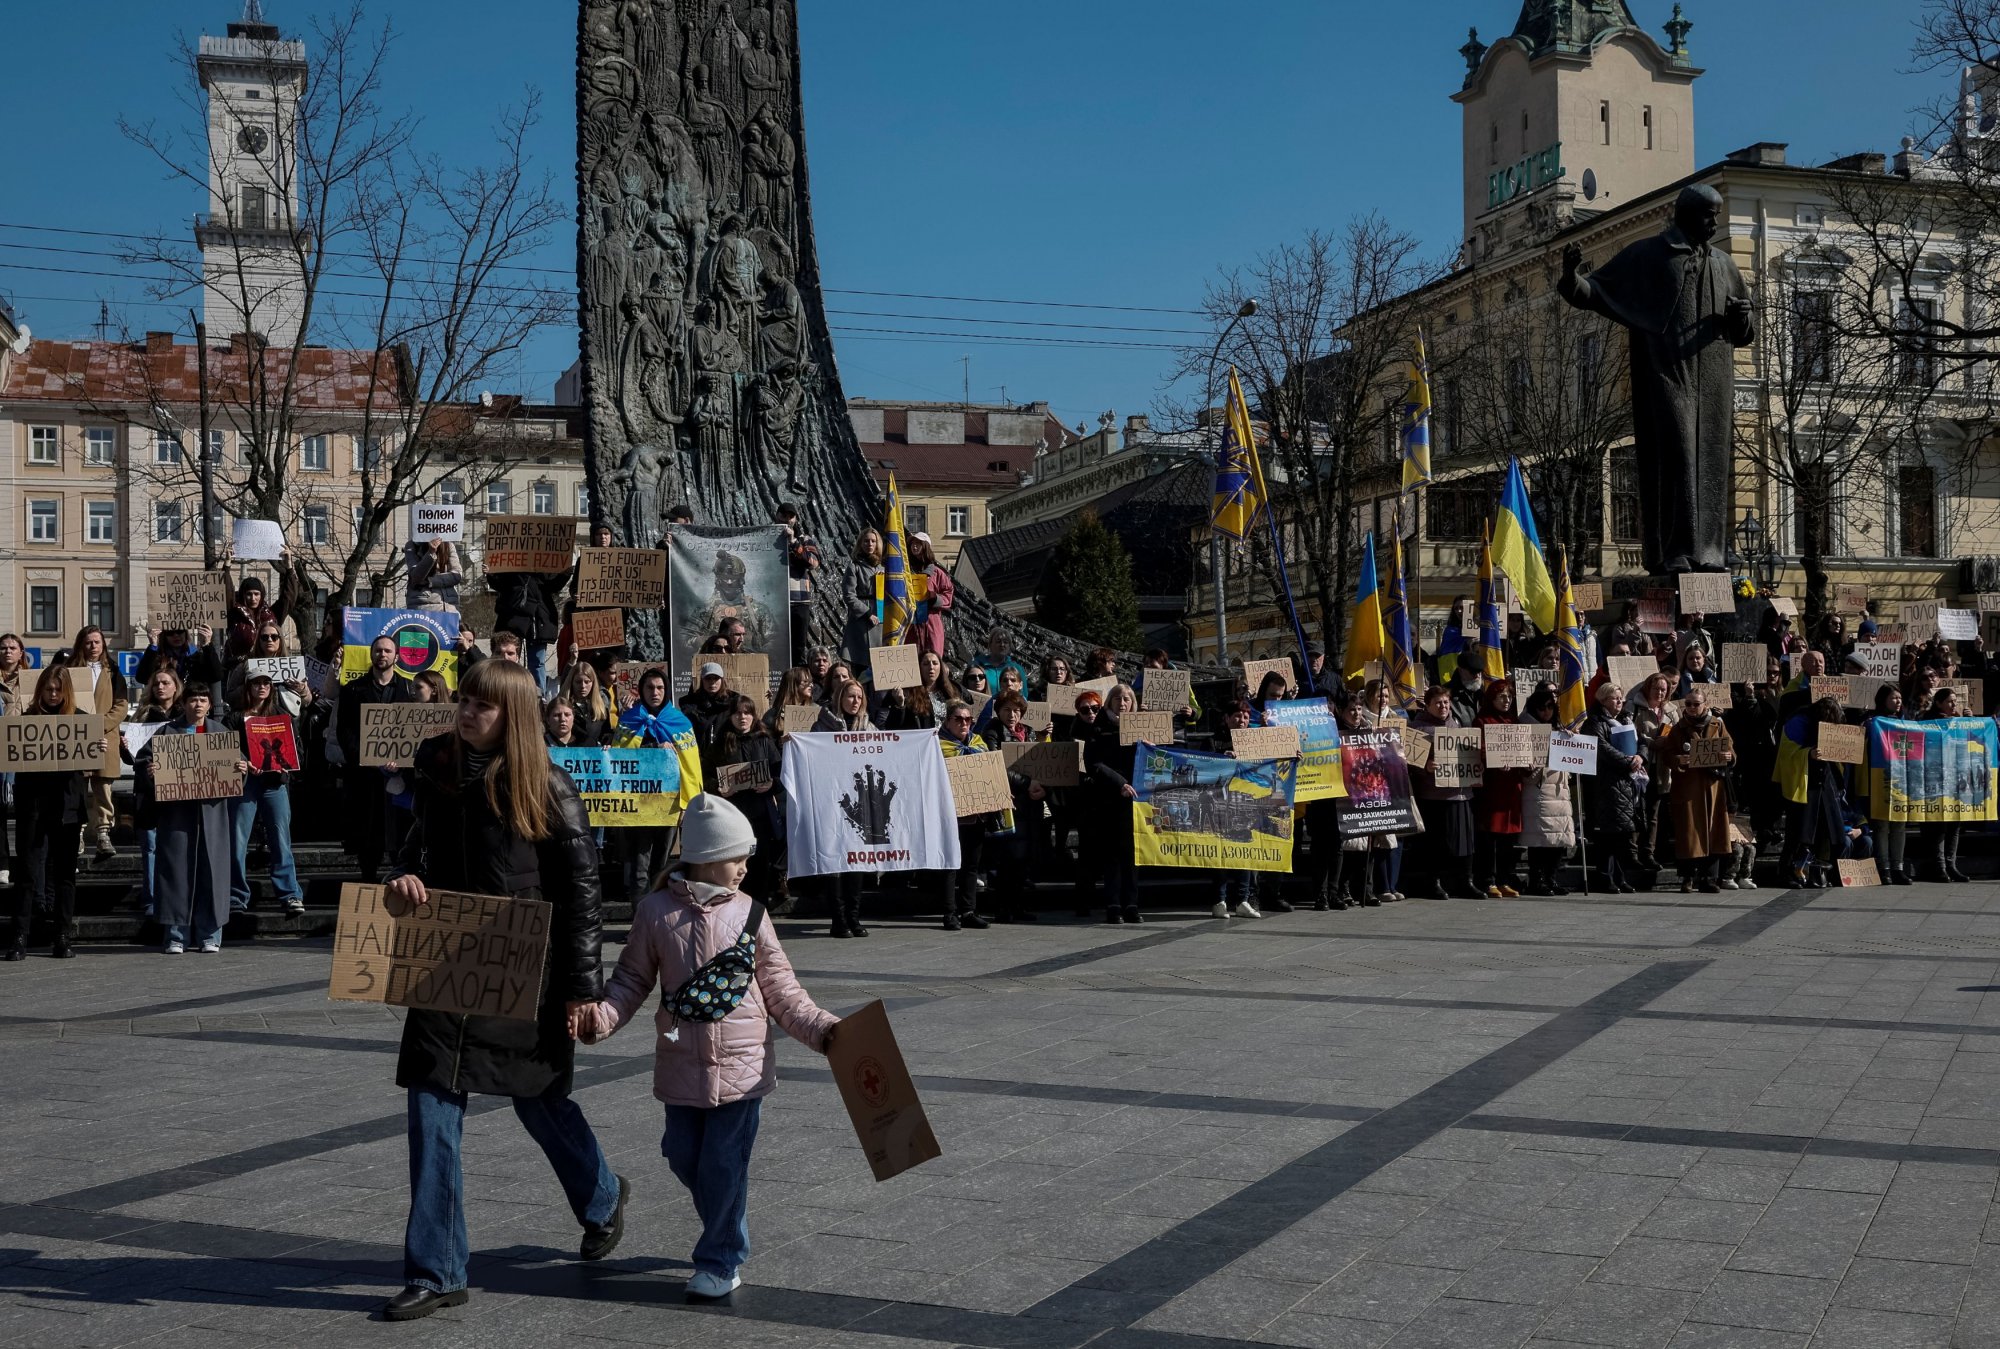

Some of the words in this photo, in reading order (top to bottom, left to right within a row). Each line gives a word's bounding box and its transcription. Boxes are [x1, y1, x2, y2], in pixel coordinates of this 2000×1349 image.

[1489, 141, 1566, 209] HOTEL
[418, 509, 454, 520] ПОЛОН
[417, 523, 458, 534] ВБИВАЄ
[488, 521, 518, 536] DON'T
[521, 523, 533, 536] BE
[488, 537, 542, 551] CAPTIVITY
[489, 553, 529, 567] #FREE
[533, 553, 569, 569] AZOV
[586, 552, 613, 565] THEY
[617, 553, 660, 566] FOUGHT
[600, 566, 622, 579] FOR
[626, 566, 642, 579] US!
[150, 575, 165, 587] НЕ
[171, 573, 227, 587] ДОПУСТИ
[581, 577, 597, 590] IT'S
[600, 579, 621, 591] OUR
[623, 580, 648, 592] TIME
[650, 581, 662, 593] TO
[174, 585, 198, 593] ЩОБ
[1572, 585, 1600, 598] FREE
[580, 592, 609, 604] FIGHT
[612, 592, 632, 604] FOR
[1685, 590, 1705, 603] БУТИ
[157, 611, 214, 621] ВМИРАЛИ
[220, 610, 228, 620] В
[162, 620, 206, 631] ПОЛОН
[378, 613, 412, 637] оверніть
[576, 616, 618, 631] ПОЛОН
[576, 627, 624, 648] ВБИВАЄ
[879, 649, 908, 664] FREE
[1724, 644, 1754, 656] БУДЬ
[125, 654, 139, 674] P
[257, 657, 298, 670] FREE
[1867, 664, 1898, 677] ИВАЄ
[268, 669, 301, 682] ZOV
[345, 671, 369, 681] 302
[880, 668, 914, 684] AZOV
[1147, 671, 1185, 680] ЧЕКАЮ
[1147, 680, 1186, 692] АЗОВЦЯ
[365, 705, 405, 726] ГЕРОЇ
[792, 710, 816, 722] ПОЛ
[1023, 709, 1047, 721] ОВЧИ
[1310, 716, 1329, 727] 3033
[7, 723, 87, 742] ПОЛОН
[367, 725, 406, 739] ДОСІ
[412, 725, 423, 739] У
[834, 733, 900, 743] ПОВЕРНІТЬ
[204, 732, 240, 750] ТВОРИТЬ
[1438, 736, 1478, 751] ПОЛОН
[1551, 739, 1596, 751] ЗВІЛЬНІТЬ
[1696, 739, 1728, 753] FREE
[1826, 734, 1856, 747] ПОЛОН
[7, 741, 98, 762] ВБИВАЄ
[853, 746, 883, 754] АЗОВ
[1017, 745, 1070, 761] ПОЛОН
[1824, 746, 1856, 761] ВБИВАЄ
[153, 754, 161, 770] З
[564, 759, 601, 773] SAVE
[610, 760, 639, 774] THE
[956, 753, 1000, 770] МОВЧИ
[1298, 753, 1339, 767] УПОЛЯ
[1533, 756, 1548, 765] AZO
[1561, 756, 1584, 765] АЗОВ
[176, 769, 186, 784] НЕ
[192, 767, 219, 783] МОВЧИ
[948, 769, 973, 783] ТАНЬ
[1436, 763, 1481, 778] ВБИВАЄ
[156, 783, 190, 800] FREEDOM
[191, 783, 204, 800] FOR
[575, 779, 611, 793] TARY
[621, 779, 662, 793] FROM
[584, 799, 638, 812] OVSTAL
[953, 791, 1011, 809] ОЛОНЕНИХ
[1354, 800, 1392, 809] «АЗОВ»
[1342, 813, 1362, 821] ВОЛЮ
[1363, 809, 1407, 819] ЗАХИСНИКАМ
[1893, 804, 1940, 814] ФОРТЕЦЯ
[1358, 818, 1397, 827] МАРІУПОЛЯ
[847, 850, 910, 864] ДОДОМУ!
[1160, 843, 1217, 859] ФОРТЕЦЯ
[1221, 846, 1281, 861] АЗОВСТАЛЬ
[1853, 877, 1873, 885] ТАТА
[354, 886, 543, 935] ПОВЕРНІТЬ
[338, 921, 452, 961] НАШИХ
[457, 931, 545, 975] РІДНИХ
[349, 960, 375, 994] З
[385, 963, 526, 1015] ПОЛОНУ
